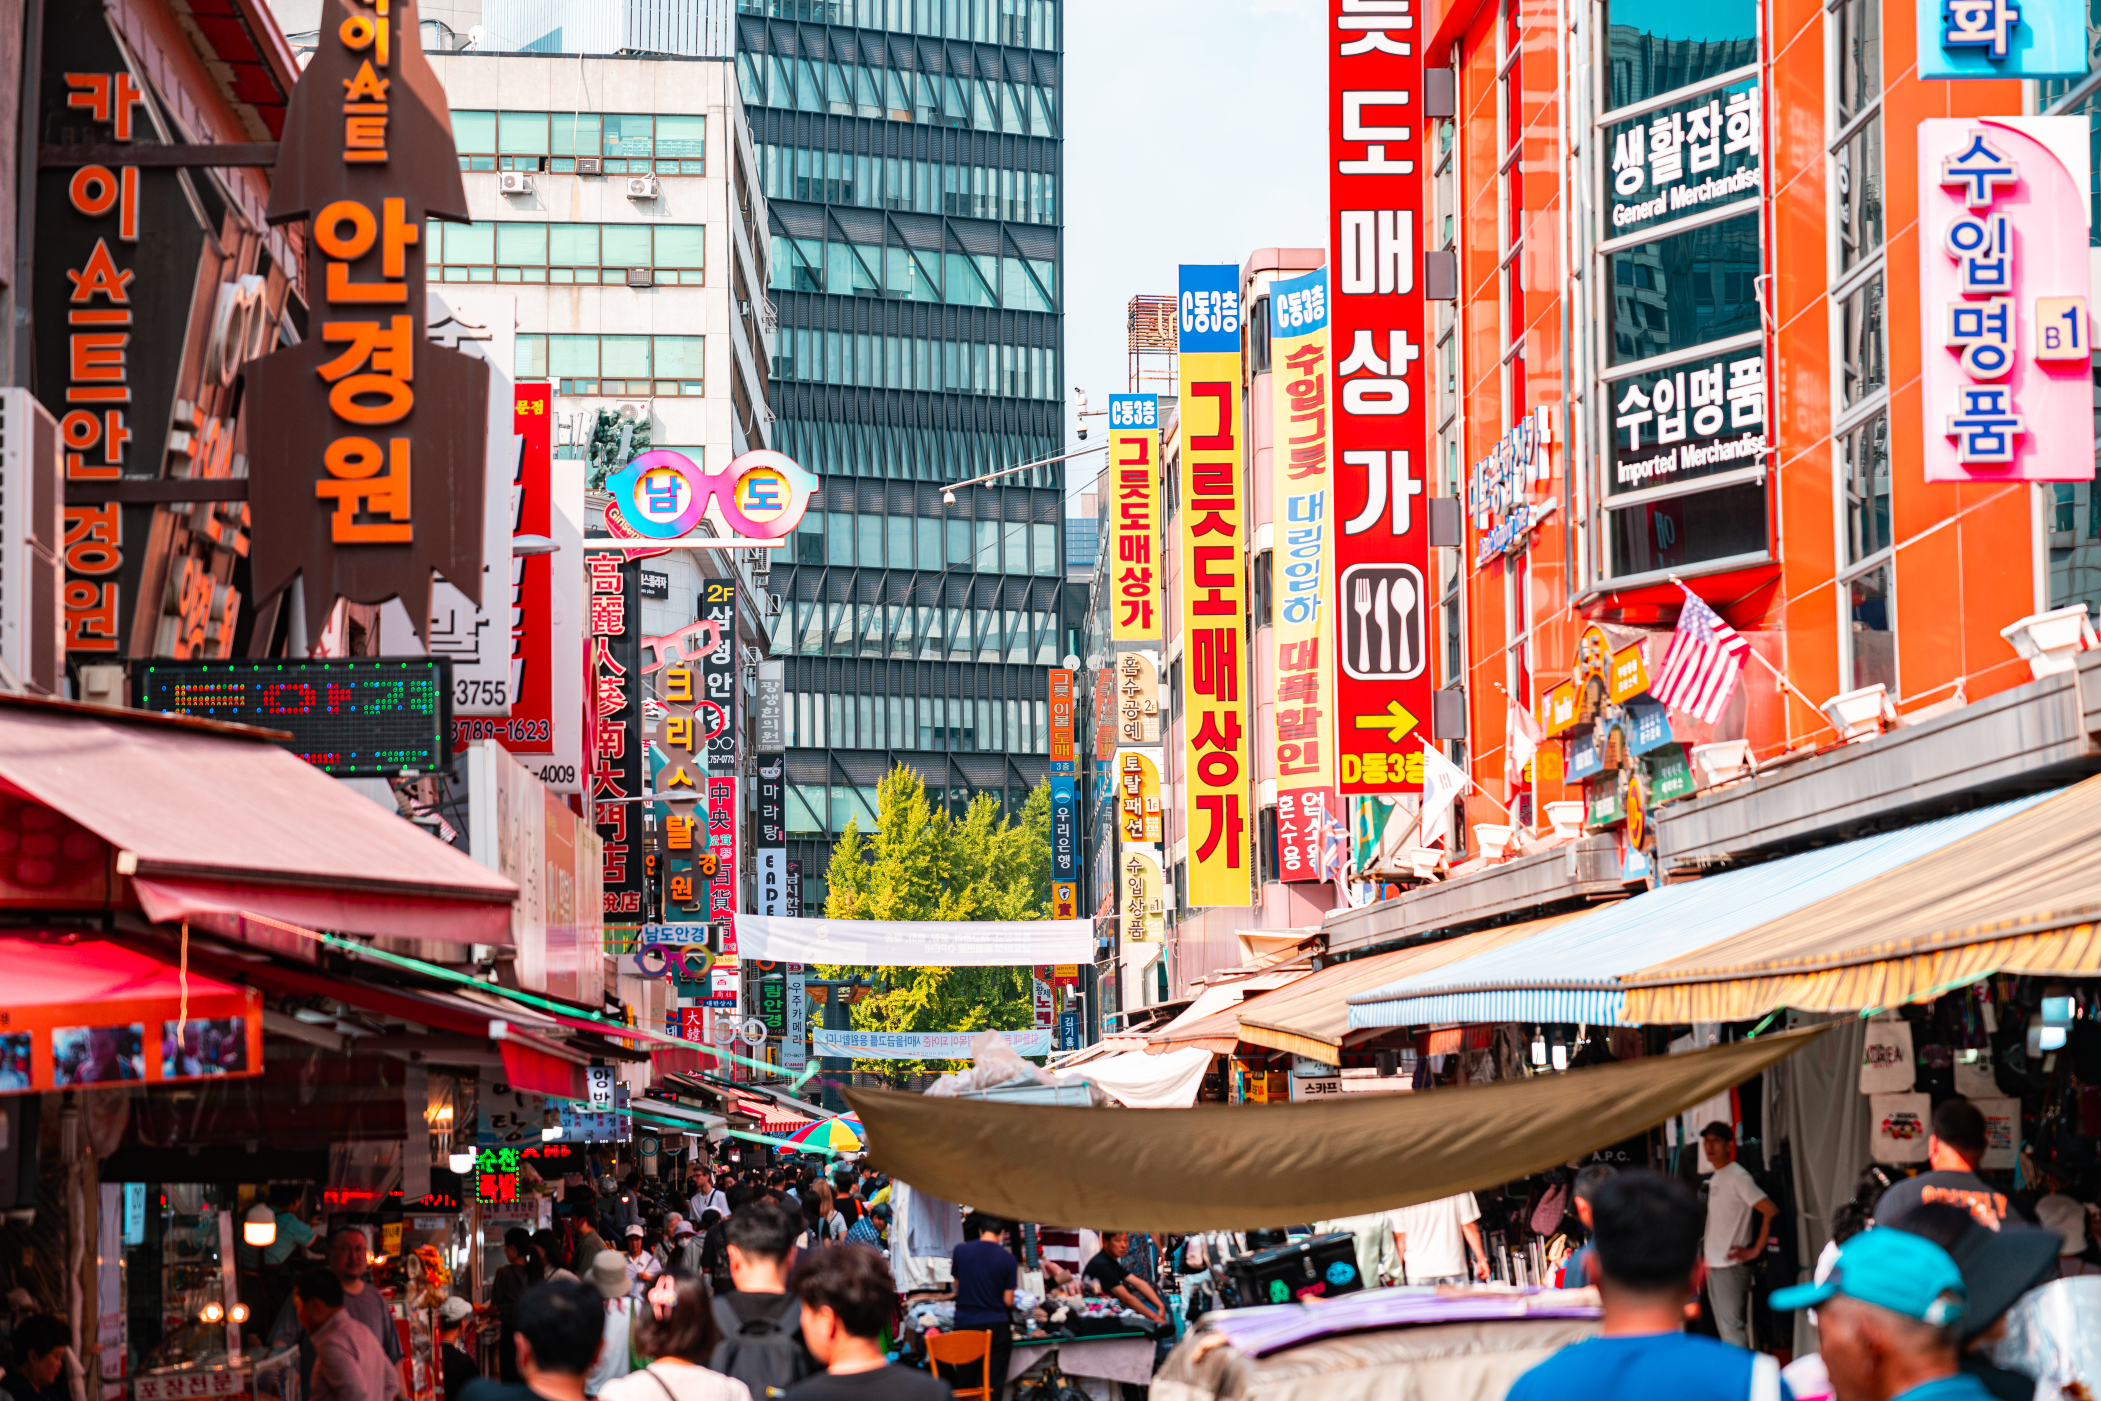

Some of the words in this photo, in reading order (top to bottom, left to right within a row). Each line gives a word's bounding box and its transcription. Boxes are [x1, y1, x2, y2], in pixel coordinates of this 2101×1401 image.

[1612, 85, 1760, 196] 생활잡화
[1613, 189, 1667, 228] General
[1670, 166, 1760, 211] Merchandise
[1181, 290, 1238, 333] C동3층
[1277, 282, 1327, 330] C동3층
[1940, 128, 2026, 464] 수입명품
[2044, 305, 2080, 350] B1
[313, 197, 418, 544] 안경원
[1111, 400, 1155, 426] C동3층
[1284, 342, 1327, 481] 수입그릇
[1616, 354, 1767, 452] 수입명품
[1617, 447, 1678, 487] Imported
[1680, 432, 1767, 468] Merchandise
[1117, 437, 1154, 630] 그릇도매상가
[707, 584, 735, 603] 2F
[1189, 380, 1245, 870] 그릇도매상가
[1053, 672, 1071, 698] 그릇
[1121, 656, 1141, 740] 혼수공예
[1144, 699, 1156, 712] 2F
[1276, 636, 1323, 777] 대폭할인
[1053, 702, 1071, 728] 이불
[666, 668, 696, 851] 크리스탈
[1053, 731, 1071, 757] 도매
[709, 782, 731, 830] 中央
[762, 783, 780, 842] 마라탕
[1122, 755, 1144, 839] 토탈패션
[1146, 798, 1158, 811] 1F
[1056, 806, 1071, 869] 우리은행
[1278, 794, 1302, 871] 혼수용
[1126, 856, 1145, 938] 수입상품
[645, 926, 704, 943] 남도안경
[791, 981, 803, 1046] 우주카메라
[1036, 995, 1052, 1030] 노래
[1305, 1082, 1338, 1094] 스카프
[1591, 1150, 1631, 1162] A.P.C.
[478, 1172, 518, 1201] 족발
